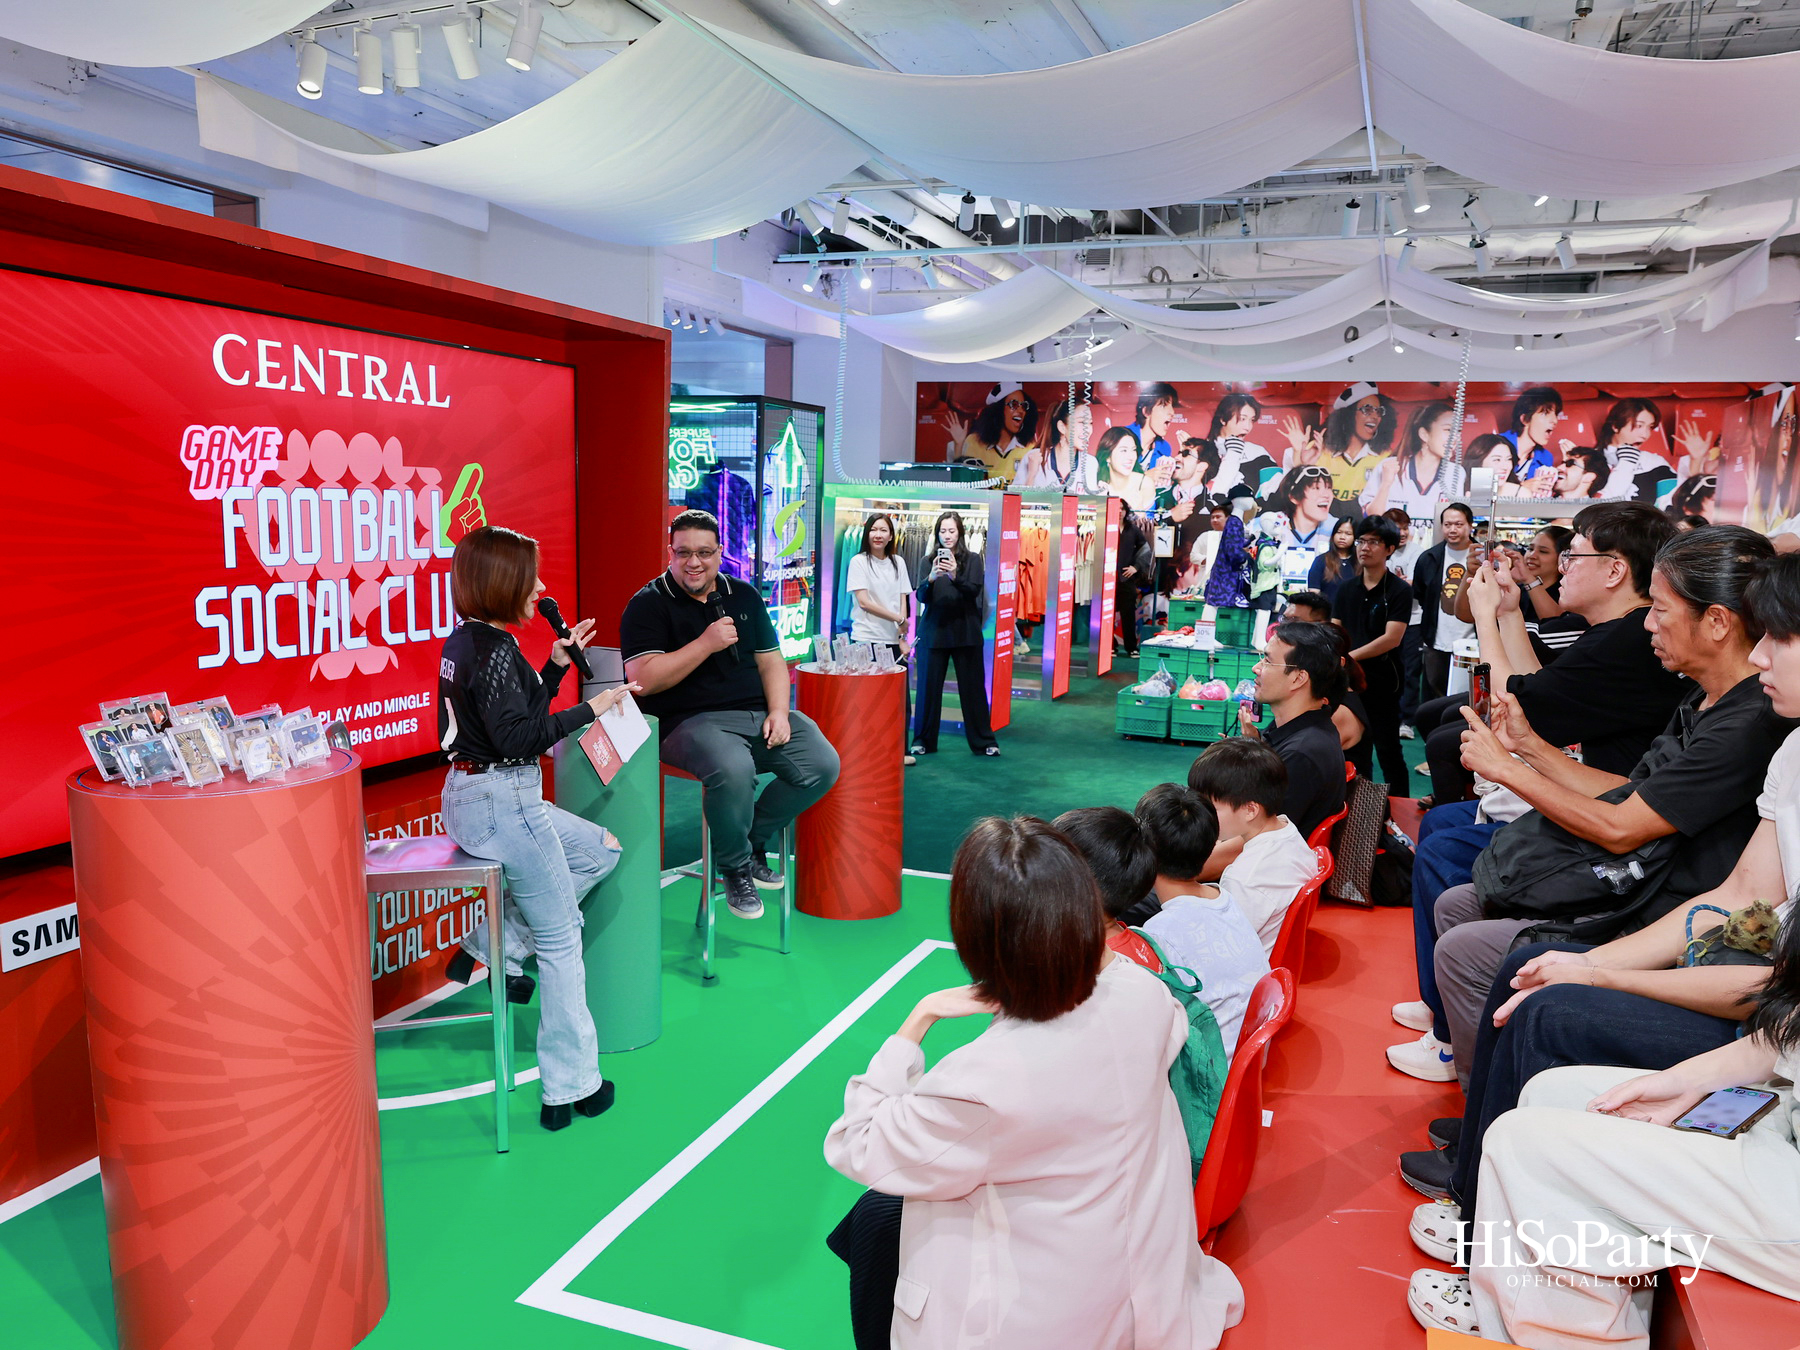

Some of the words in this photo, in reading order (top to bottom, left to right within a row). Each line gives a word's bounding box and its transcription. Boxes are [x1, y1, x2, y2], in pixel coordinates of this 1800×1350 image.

[212, 333, 451, 408] CENTRAL
[184, 429, 276, 461] GAME
[193, 458, 257, 490] DAY
[1332, 489, 1364, 500] RAS
[222, 486, 456, 569] FOOTBALL
[763, 566, 814, 582] SUPERSPORTS
[195, 578, 368, 669] SOCIAL
[380, 571, 462, 646] CLU
[318, 706, 353, 724] PLAY
[354, 701, 382, 721] AND
[384, 692, 430, 714] MINGLE
[350, 728, 372, 746] BIG
[374, 718, 418, 740] GAMES
[368, 812, 446, 842] ENTR
[377, 886, 475, 931] OOTBA
[372, 923, 431, 981] OCIAL
